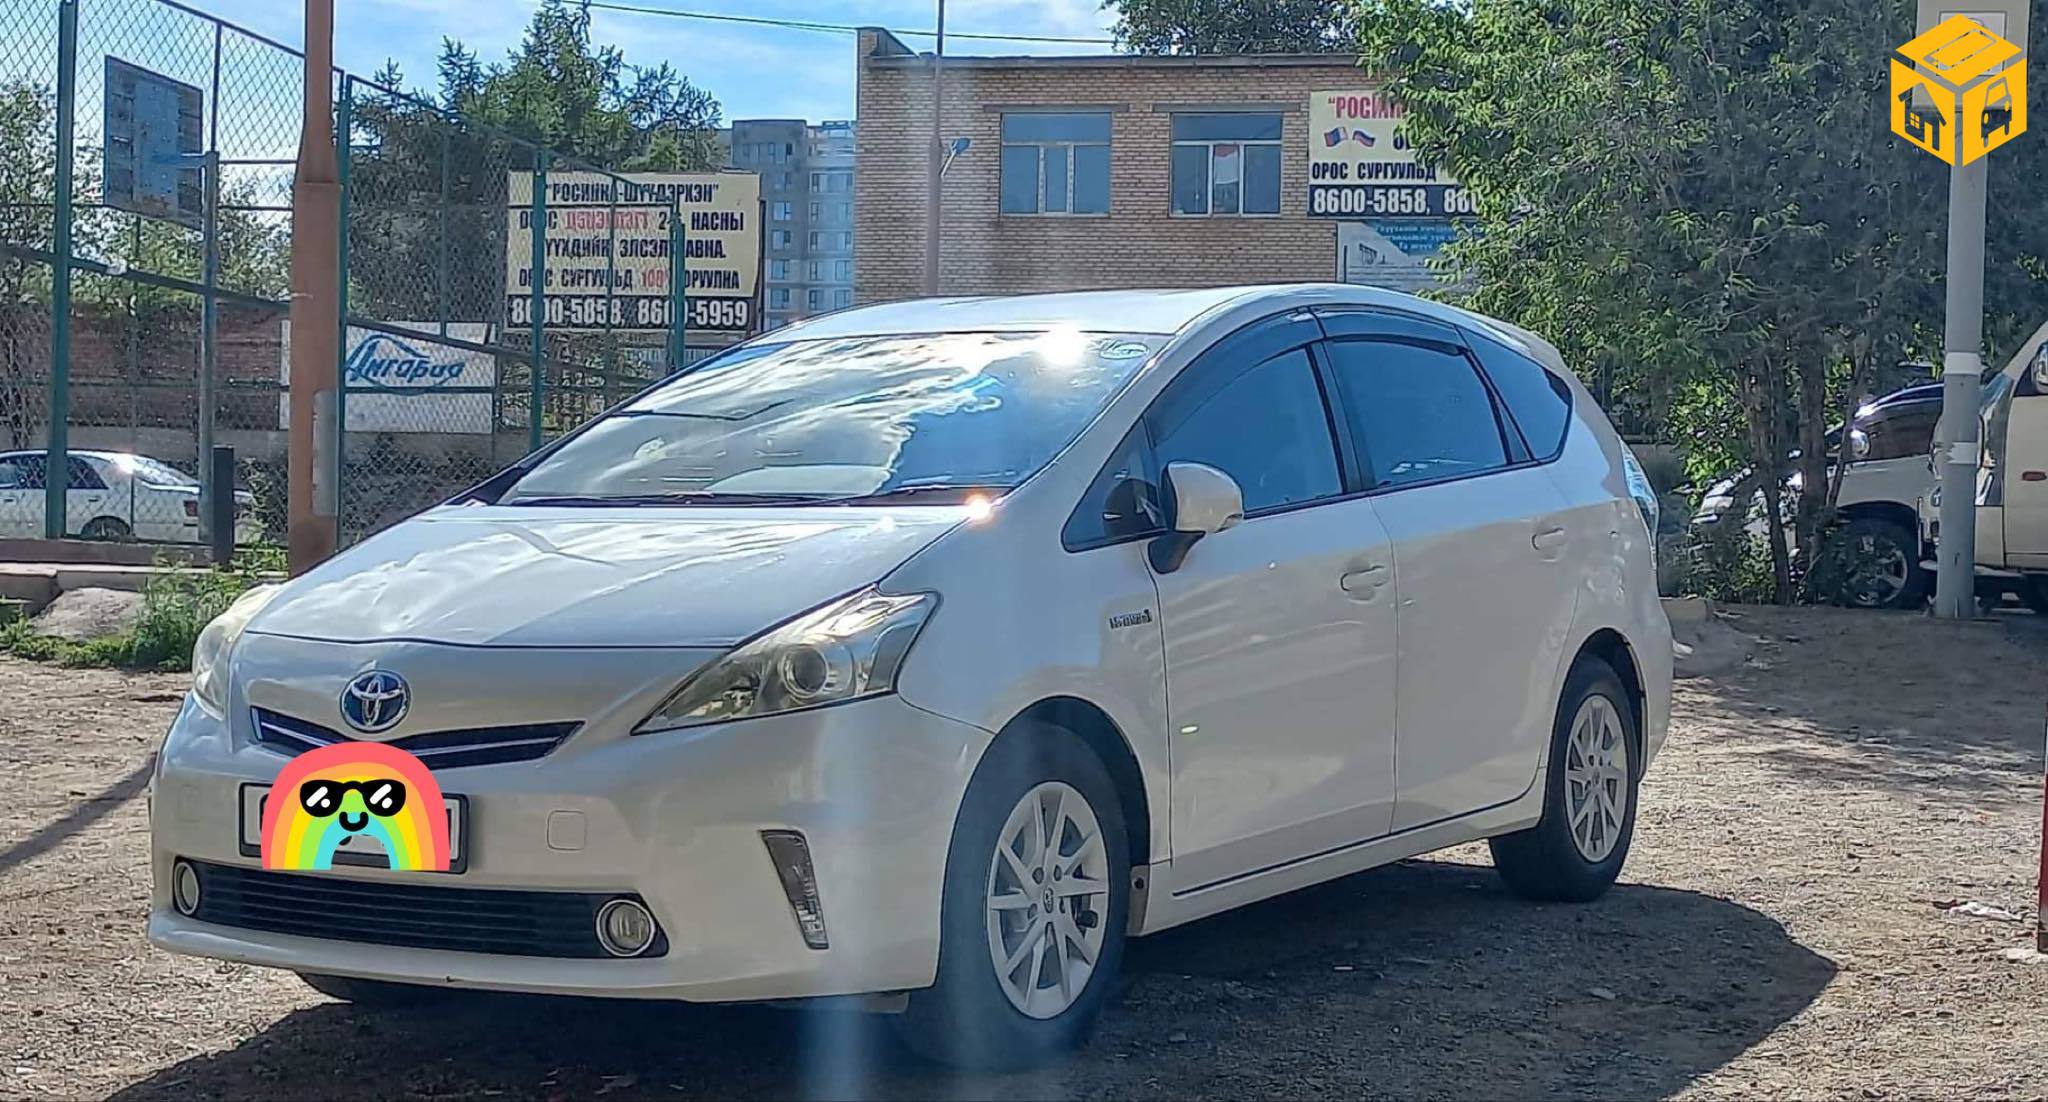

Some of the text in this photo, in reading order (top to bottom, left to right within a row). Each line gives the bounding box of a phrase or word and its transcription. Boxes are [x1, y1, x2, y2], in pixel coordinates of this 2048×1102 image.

[1312, 163, 1348, 179] ОРОС
[1313, 188, 1431, 215] 8600-5858,
[691, 211, 744, 231] НАСНЫ
[619, 239, 671, 258] ЭЛСЭЛ
